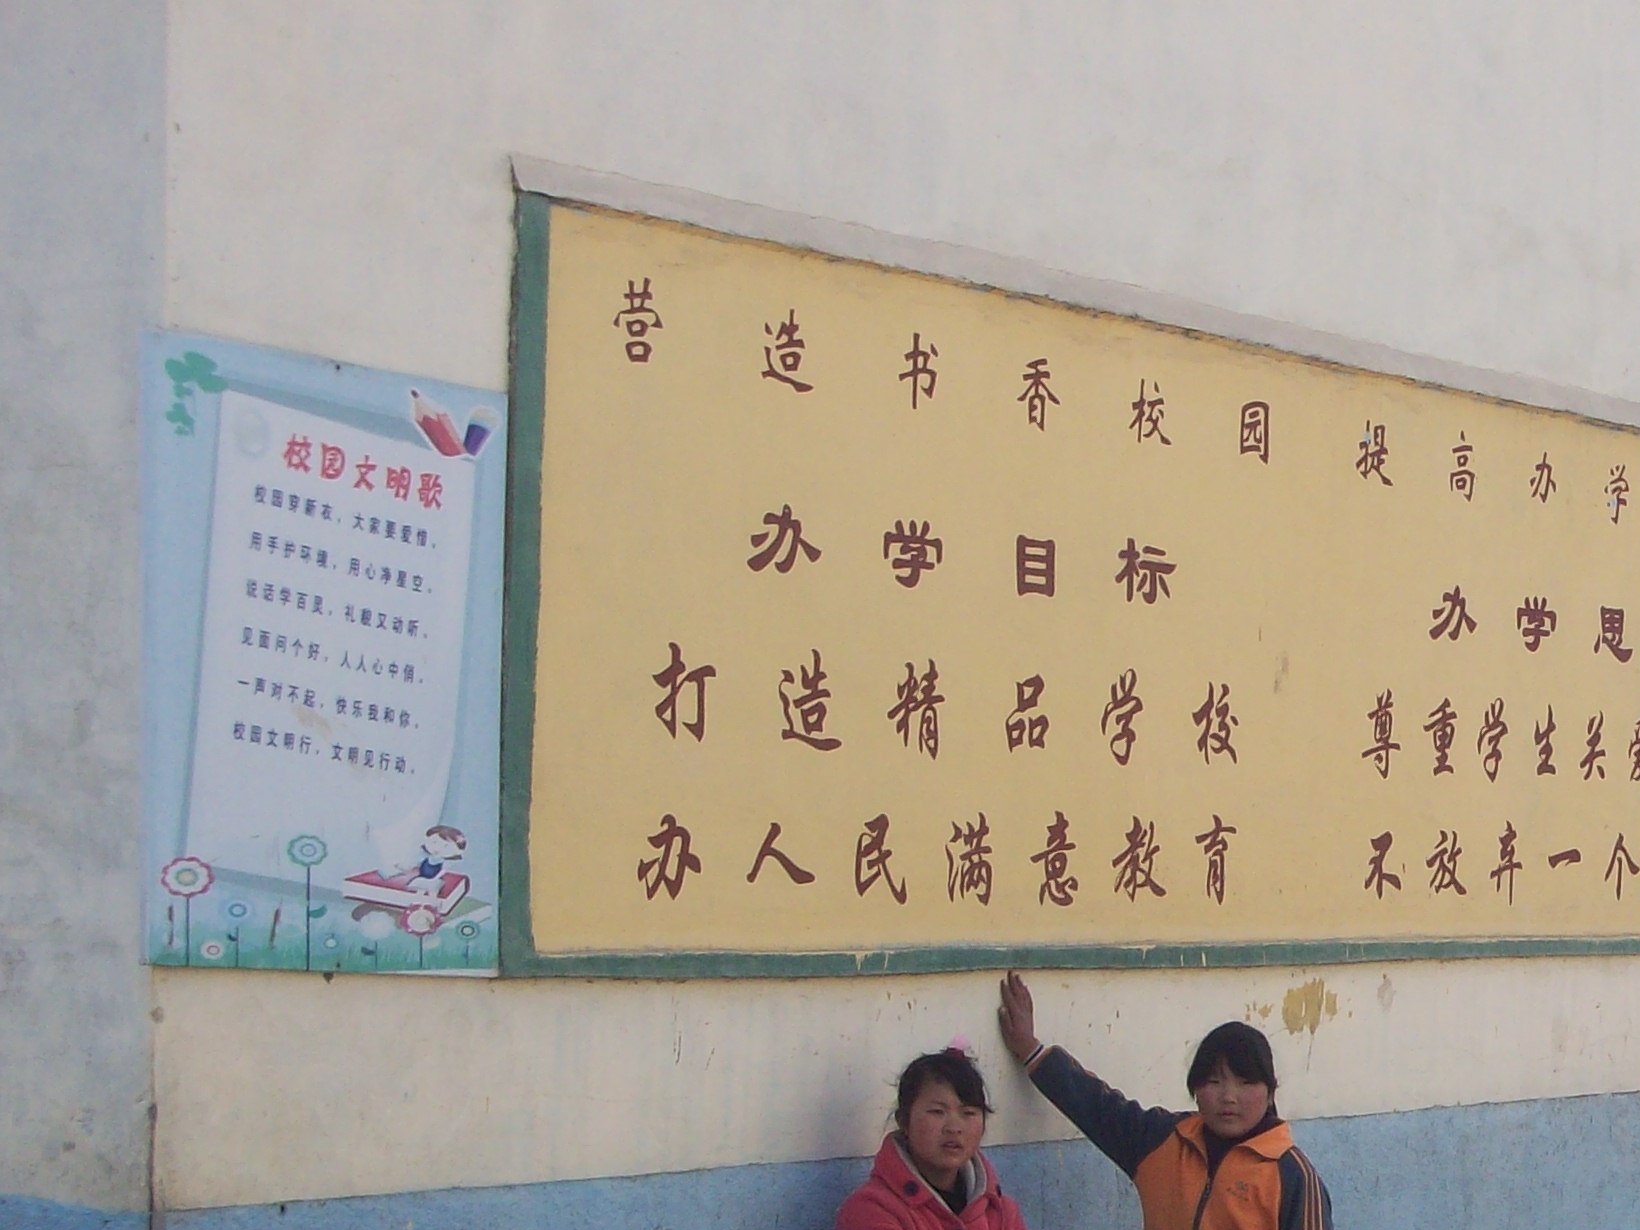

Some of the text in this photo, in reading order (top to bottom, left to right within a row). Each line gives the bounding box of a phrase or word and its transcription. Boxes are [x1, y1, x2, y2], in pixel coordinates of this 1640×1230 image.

[613, 278, 1269, 463] 营造书香校园
[283, 433, 444, 509] 校园文明歌
[748, 504, 1176, 603] 办学目标
[651, 642, 1238, 766] 打造精品学校
[636, 811, 1238, 906] 办人民满意教育
